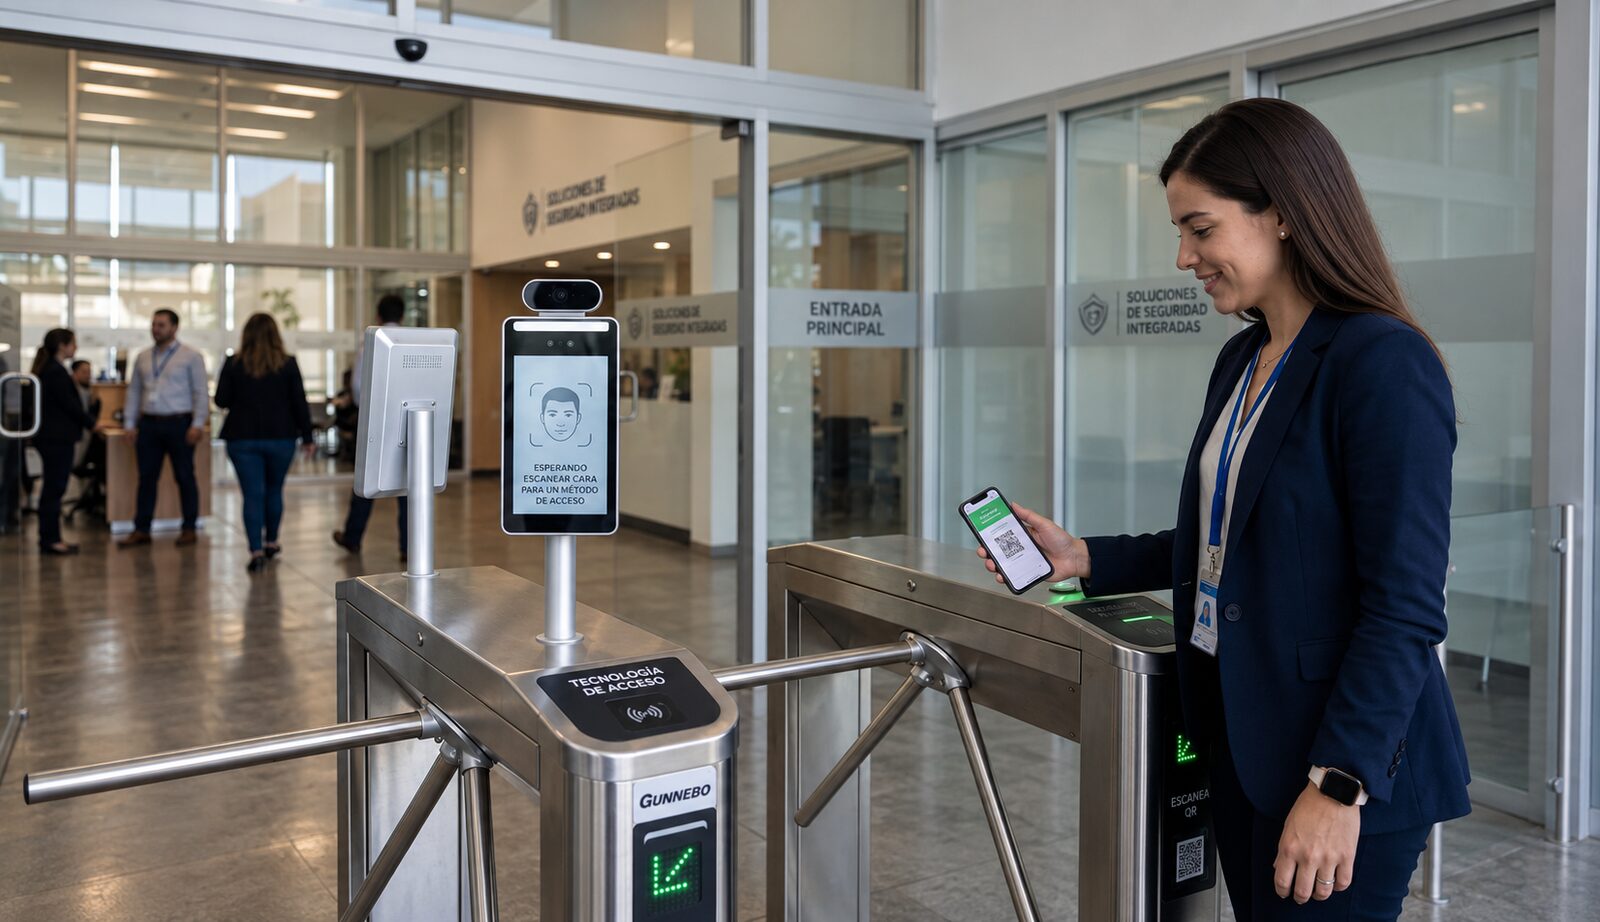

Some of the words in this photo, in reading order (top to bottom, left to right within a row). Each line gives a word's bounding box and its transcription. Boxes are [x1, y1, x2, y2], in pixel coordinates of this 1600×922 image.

[1126, 286, 1198, 303] SOLUCIONES
[810, 301, 883, 317] ENTRADA
[1126, 306, 1141, 319] DE
[1144, 303, 1208, 318] SEGURIDAD
[806, 321, 885, 336] PRINCIPAL
[1126, 320, 1201, 335] INTEGRADAS
[533, 463, 588, 472] ESPERANDO
[523, 474, 571, 483] ESCANEAR
[572, 474, 598, 483] CARA
[521, 486, 545, 494] PARA
[546, 486, 560, 494] UN
[561, 484, 599, 494] MÉTODO
[535, 497, 548, 505] DE
[549, 496, 585, 505] ACCESO
[568, 666, 664, 688] TECNOLOGÍA
[582, 685, 606, 697] DE
[608, 676, 666, 693] ACCESO
[639, 783, 711, 809] GUNNEBO
[1171, 788, 1210, 808] ESCANEA
[1184, 805, 1197, 818] QR
